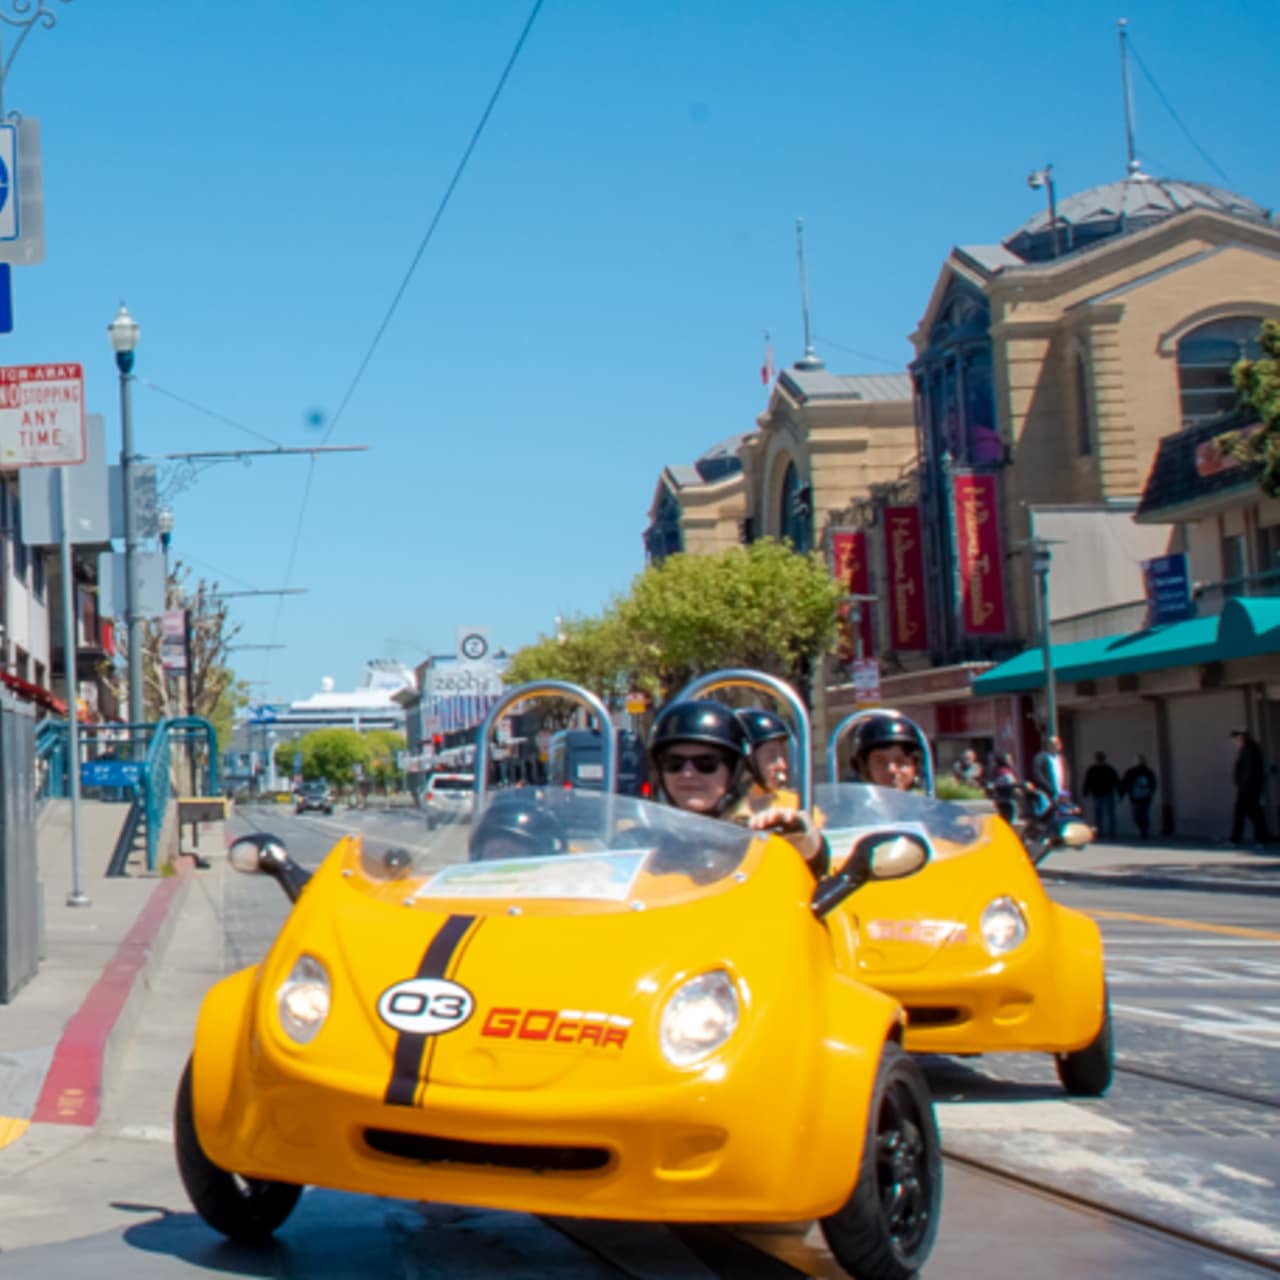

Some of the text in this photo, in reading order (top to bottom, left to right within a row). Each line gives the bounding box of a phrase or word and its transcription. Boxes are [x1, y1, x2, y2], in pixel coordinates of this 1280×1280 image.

[22, 384, 80, 405] STOPPING
[21, 408, 58, 426] ANY
[18, 427, 64, 447] TIME
[388, 990, 467, 1020] 03
